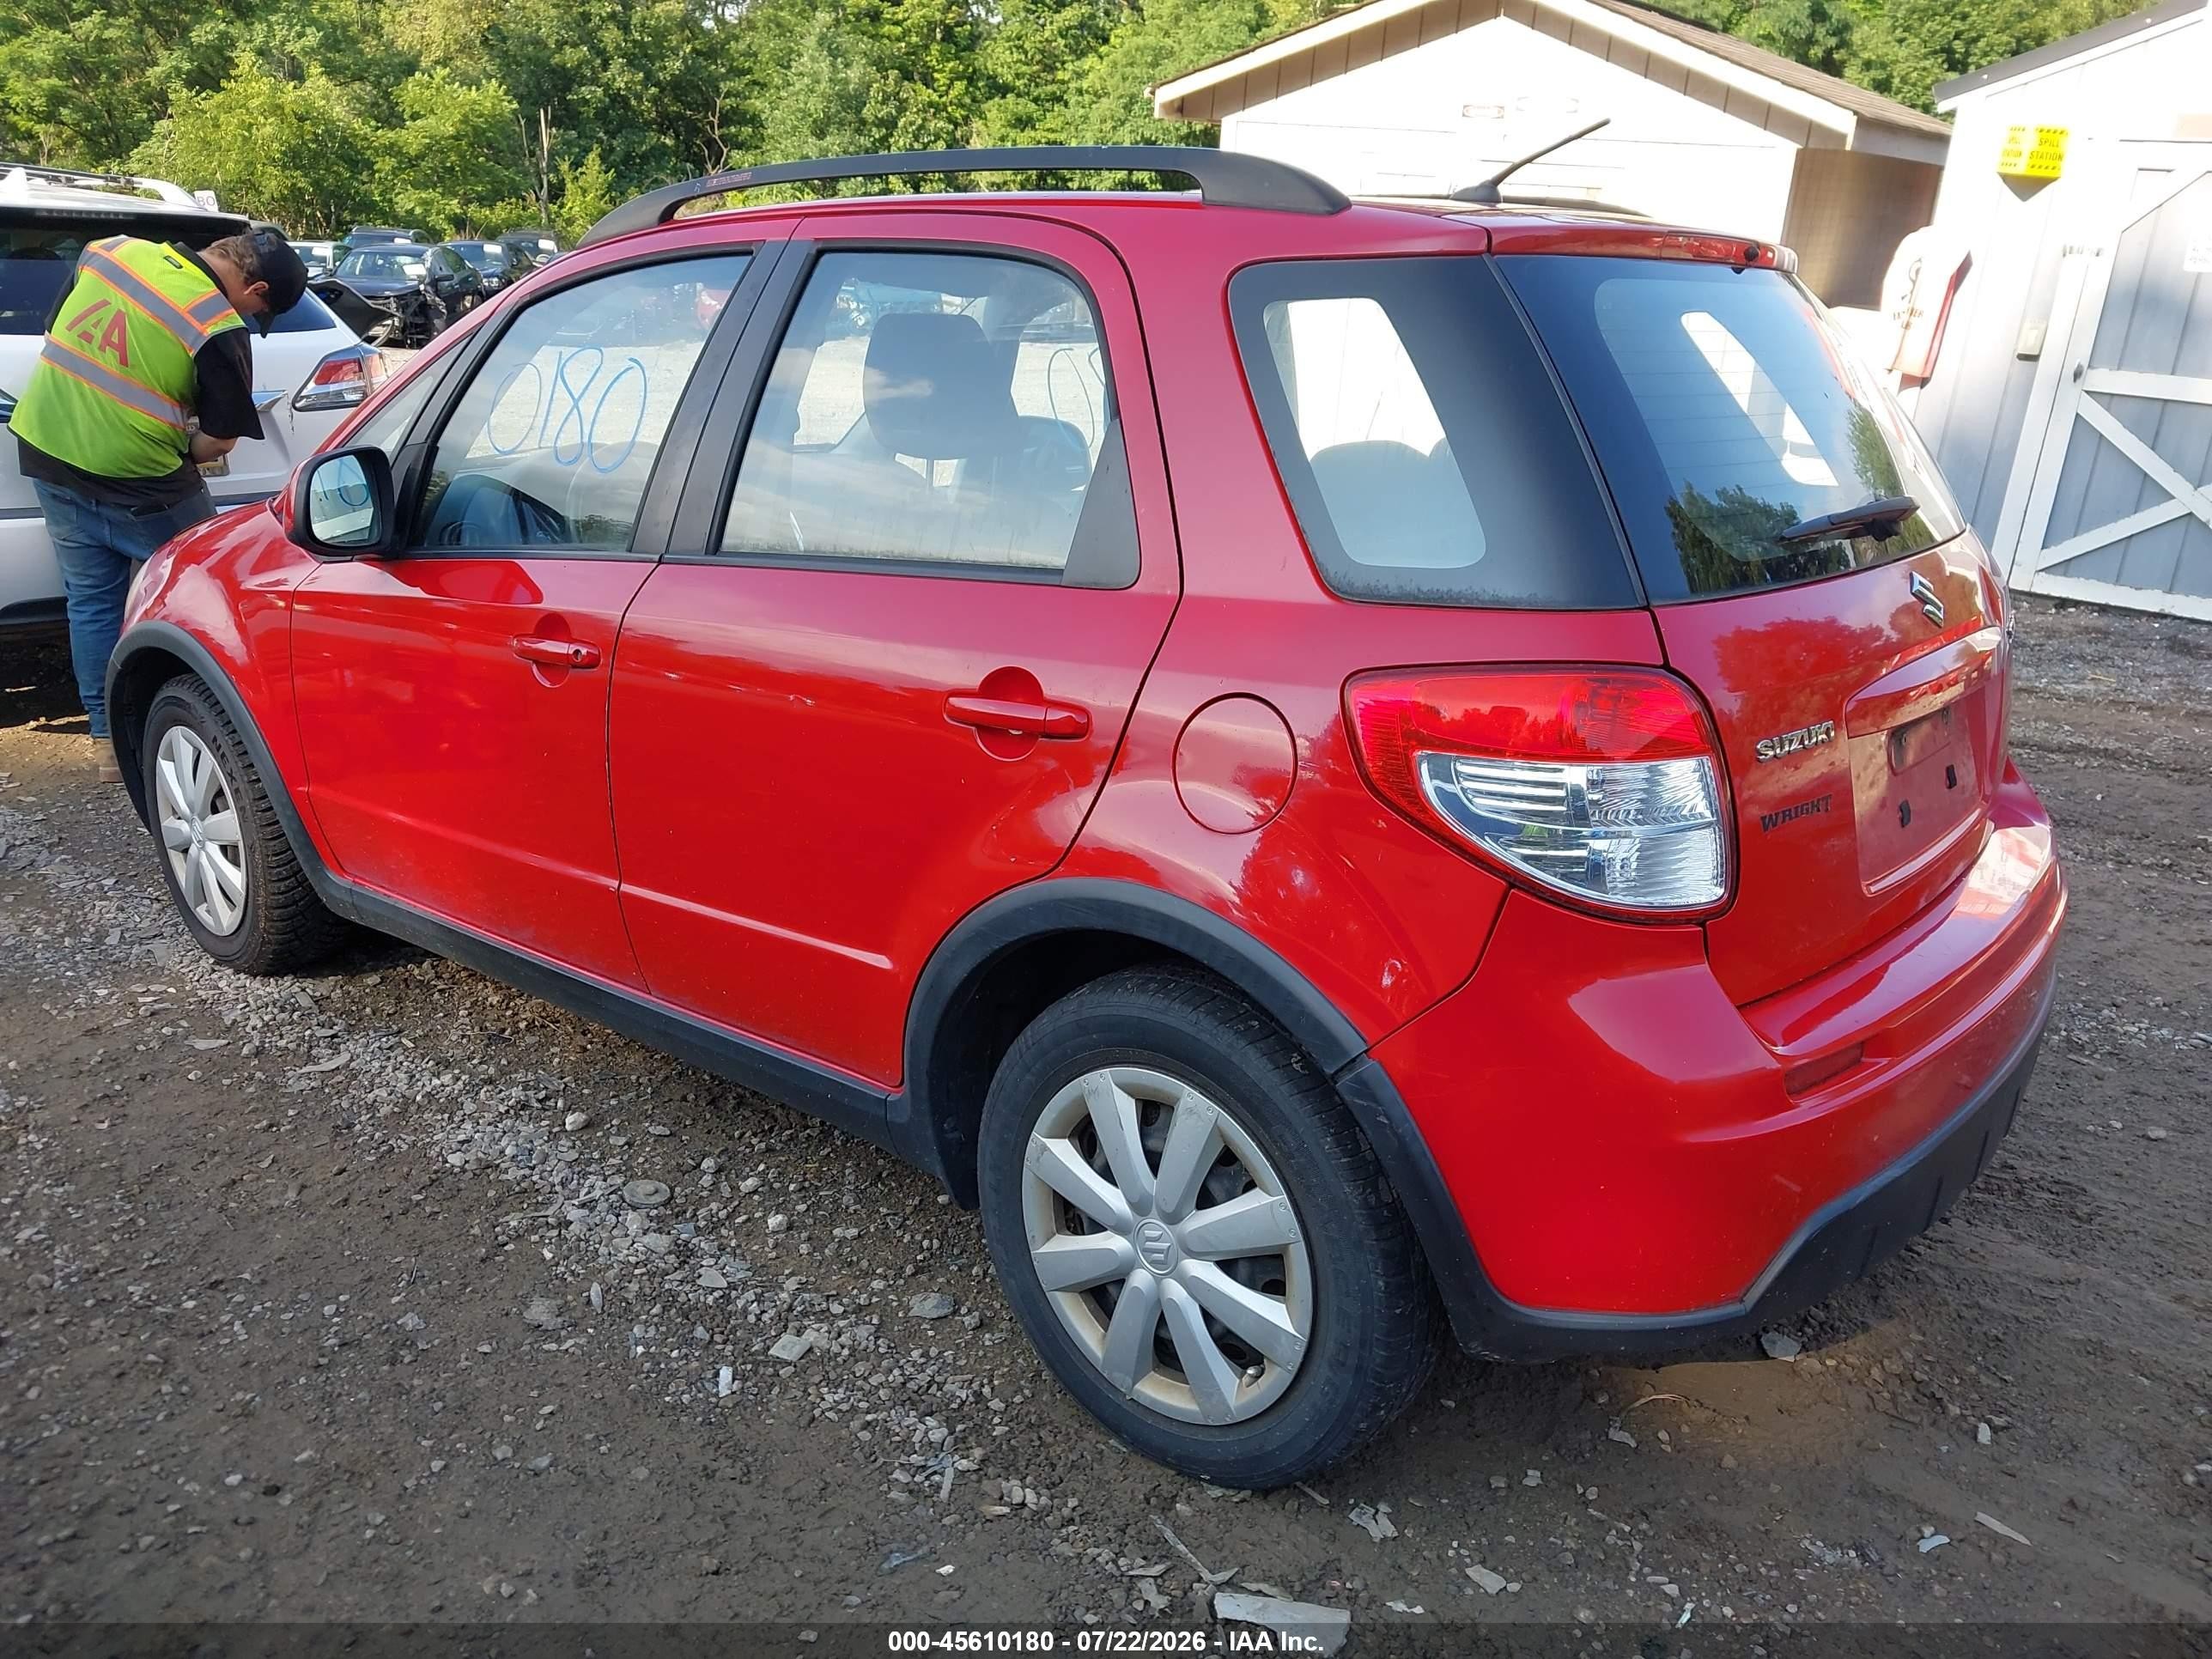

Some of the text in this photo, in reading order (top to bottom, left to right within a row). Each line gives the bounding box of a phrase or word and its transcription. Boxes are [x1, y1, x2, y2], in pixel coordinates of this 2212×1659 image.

[2029, 150, 2064, 162] STATION
[2038, 137, 2060, 148] SPILL
[486, 346, 648, 473] 0180
[1755, 719, 1836, 763] SUZUKI
[1759, 794, 1833, 834] WRIGHT
